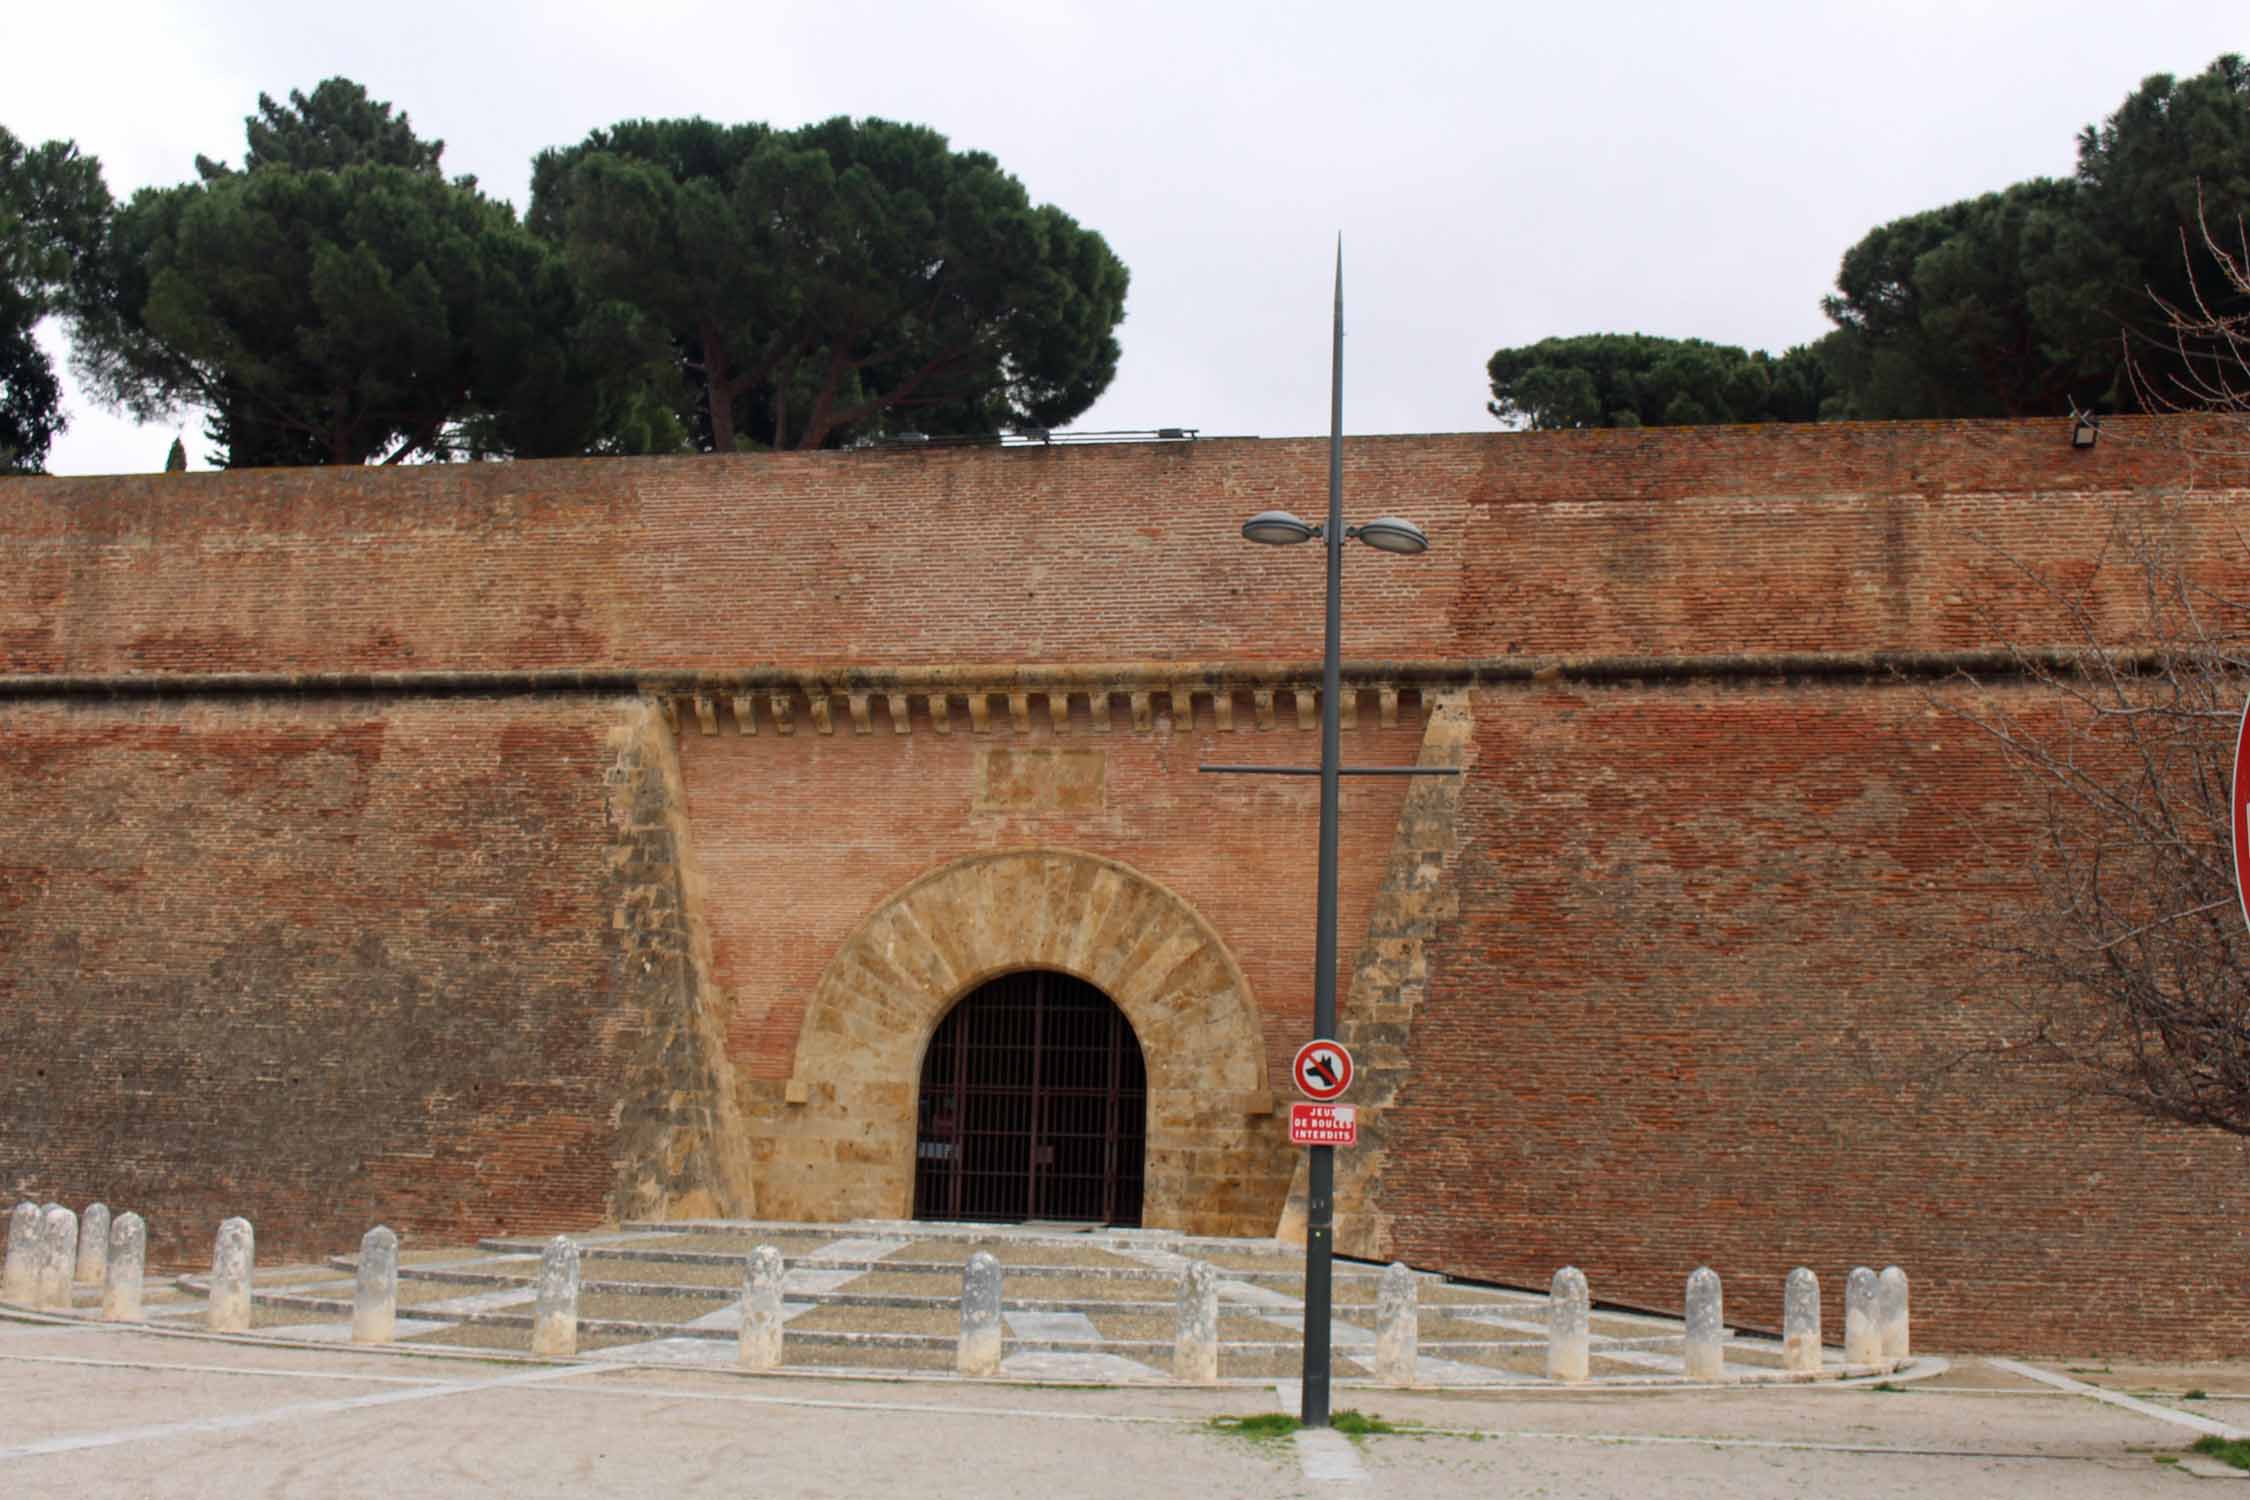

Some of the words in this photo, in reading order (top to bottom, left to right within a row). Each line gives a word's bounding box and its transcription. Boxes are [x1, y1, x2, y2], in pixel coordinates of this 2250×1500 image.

[1295, 1118, 1307, 1128] DE
[1312, 1118, 1352, 1129] BOULES
[1295, 1129, 1350, 1140] INTERDITS
